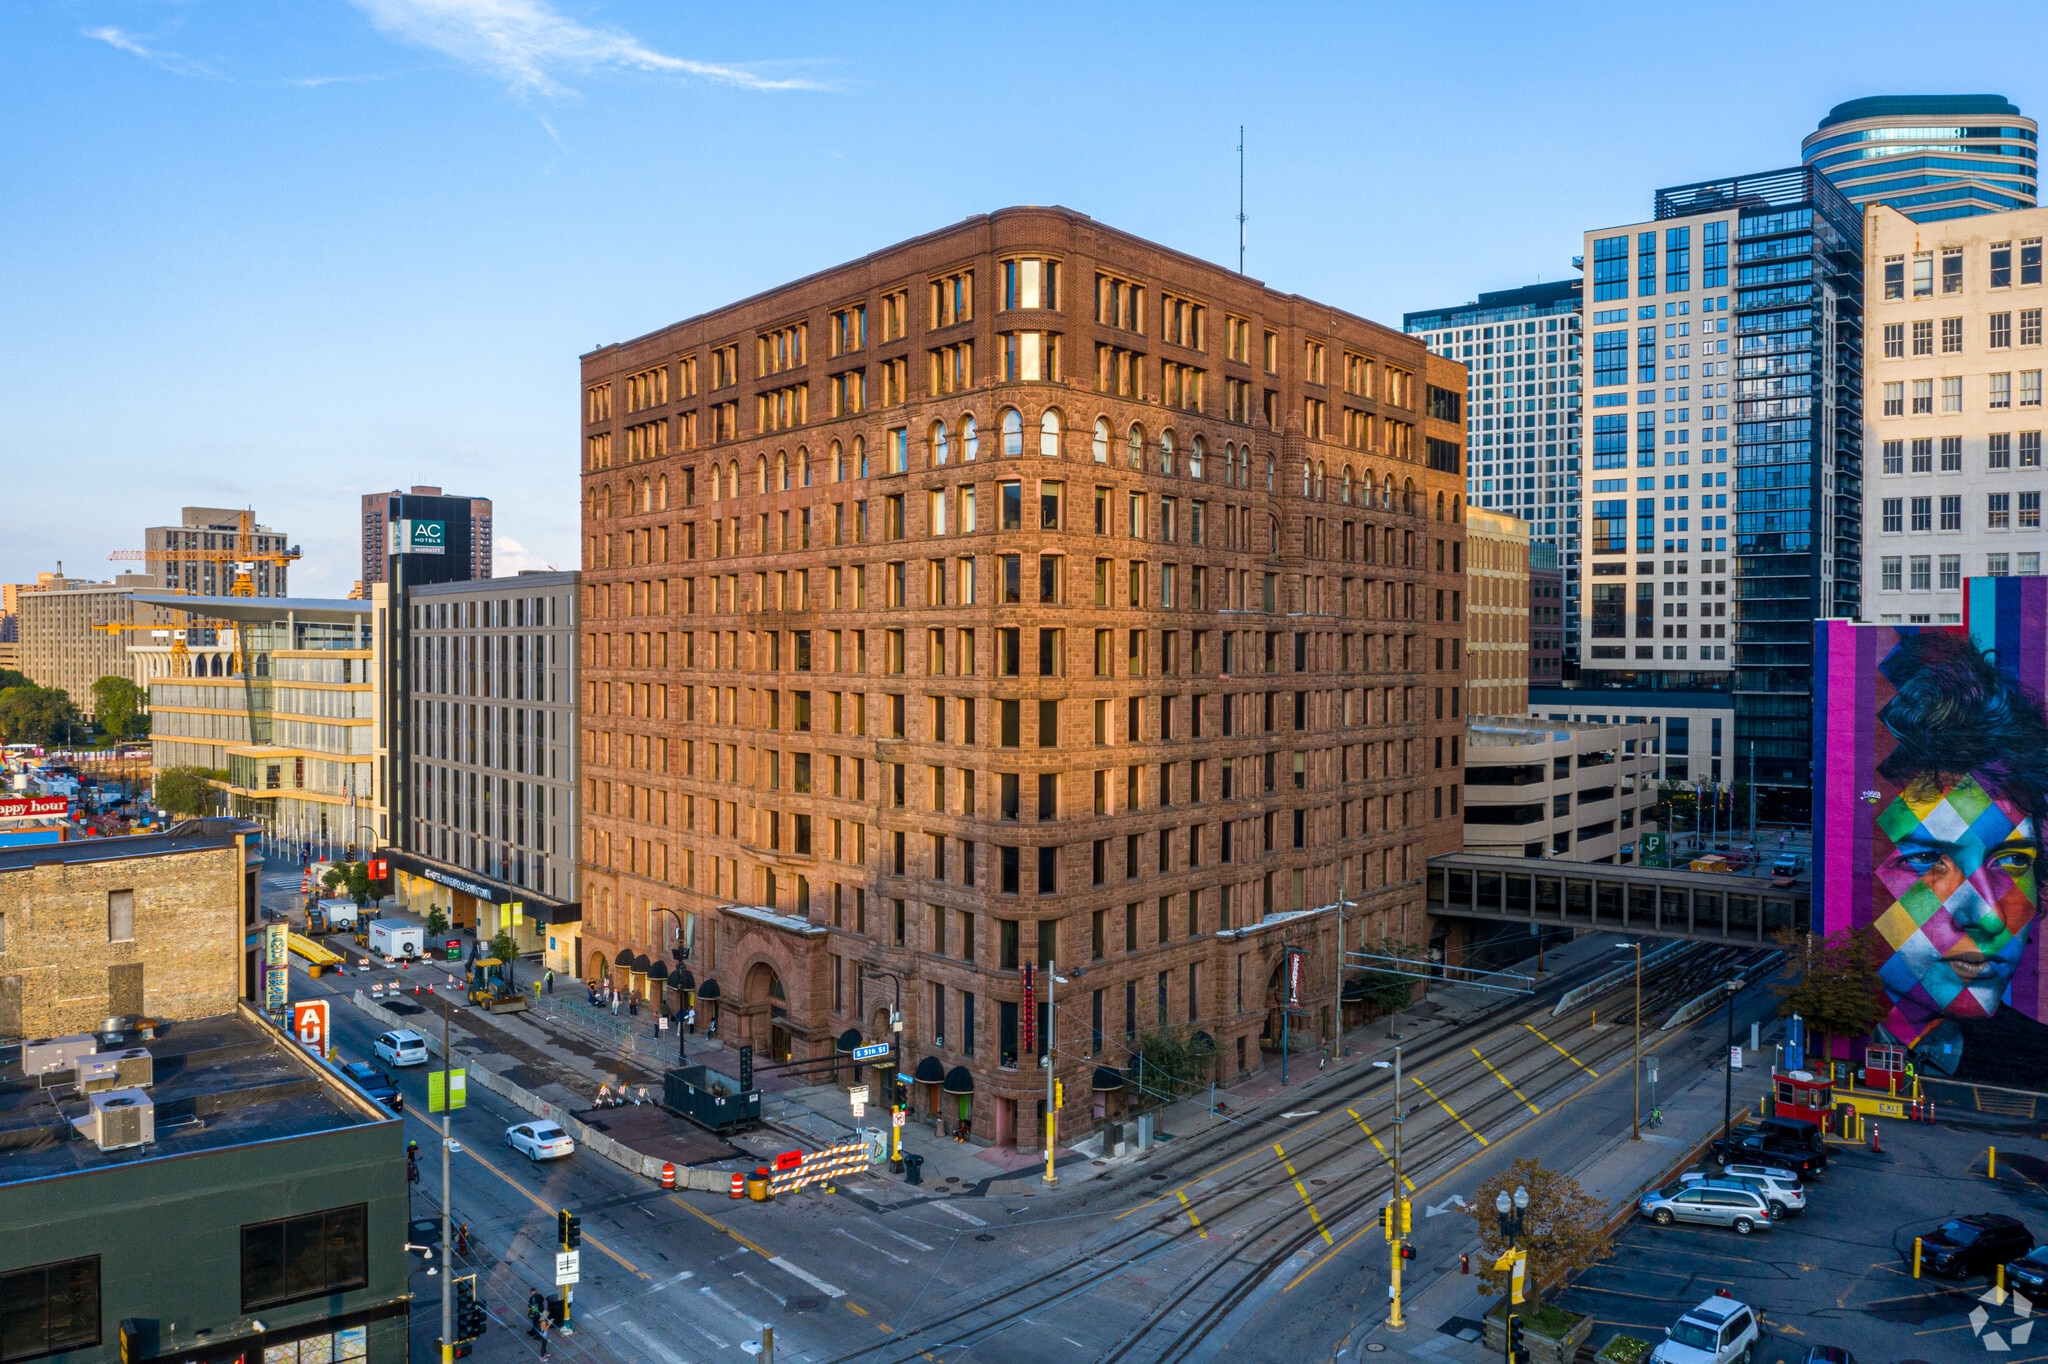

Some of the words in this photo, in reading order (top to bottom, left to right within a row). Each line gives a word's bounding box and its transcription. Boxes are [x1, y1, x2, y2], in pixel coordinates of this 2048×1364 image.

[415, 524, 441, 537] AC
[30, 800, 67, 812] hour
[1879, 1103, 1900, 1113] EXIT
